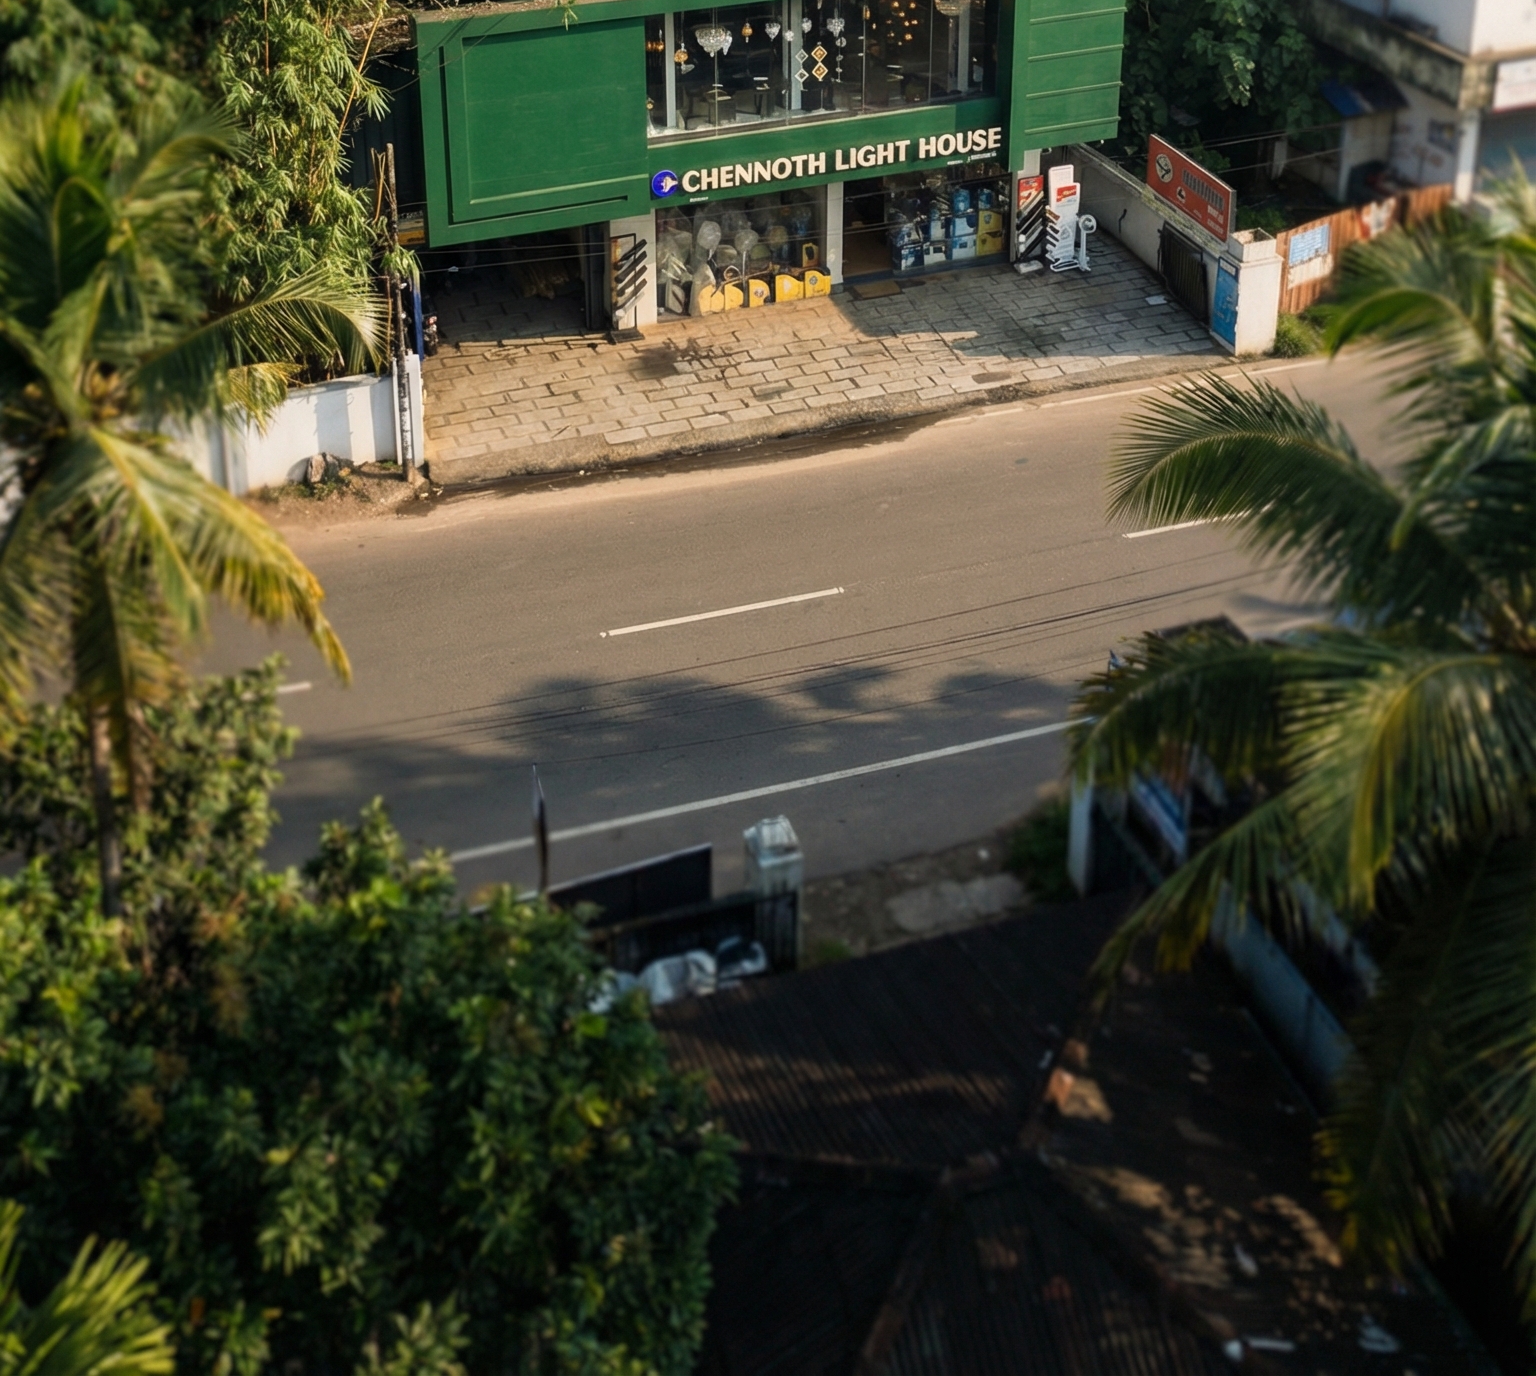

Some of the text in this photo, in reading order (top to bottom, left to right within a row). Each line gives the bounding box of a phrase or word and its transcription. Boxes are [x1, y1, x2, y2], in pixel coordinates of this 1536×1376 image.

[681, 127, 1003, 193] CHENNOTH LIGHT HOUSE
